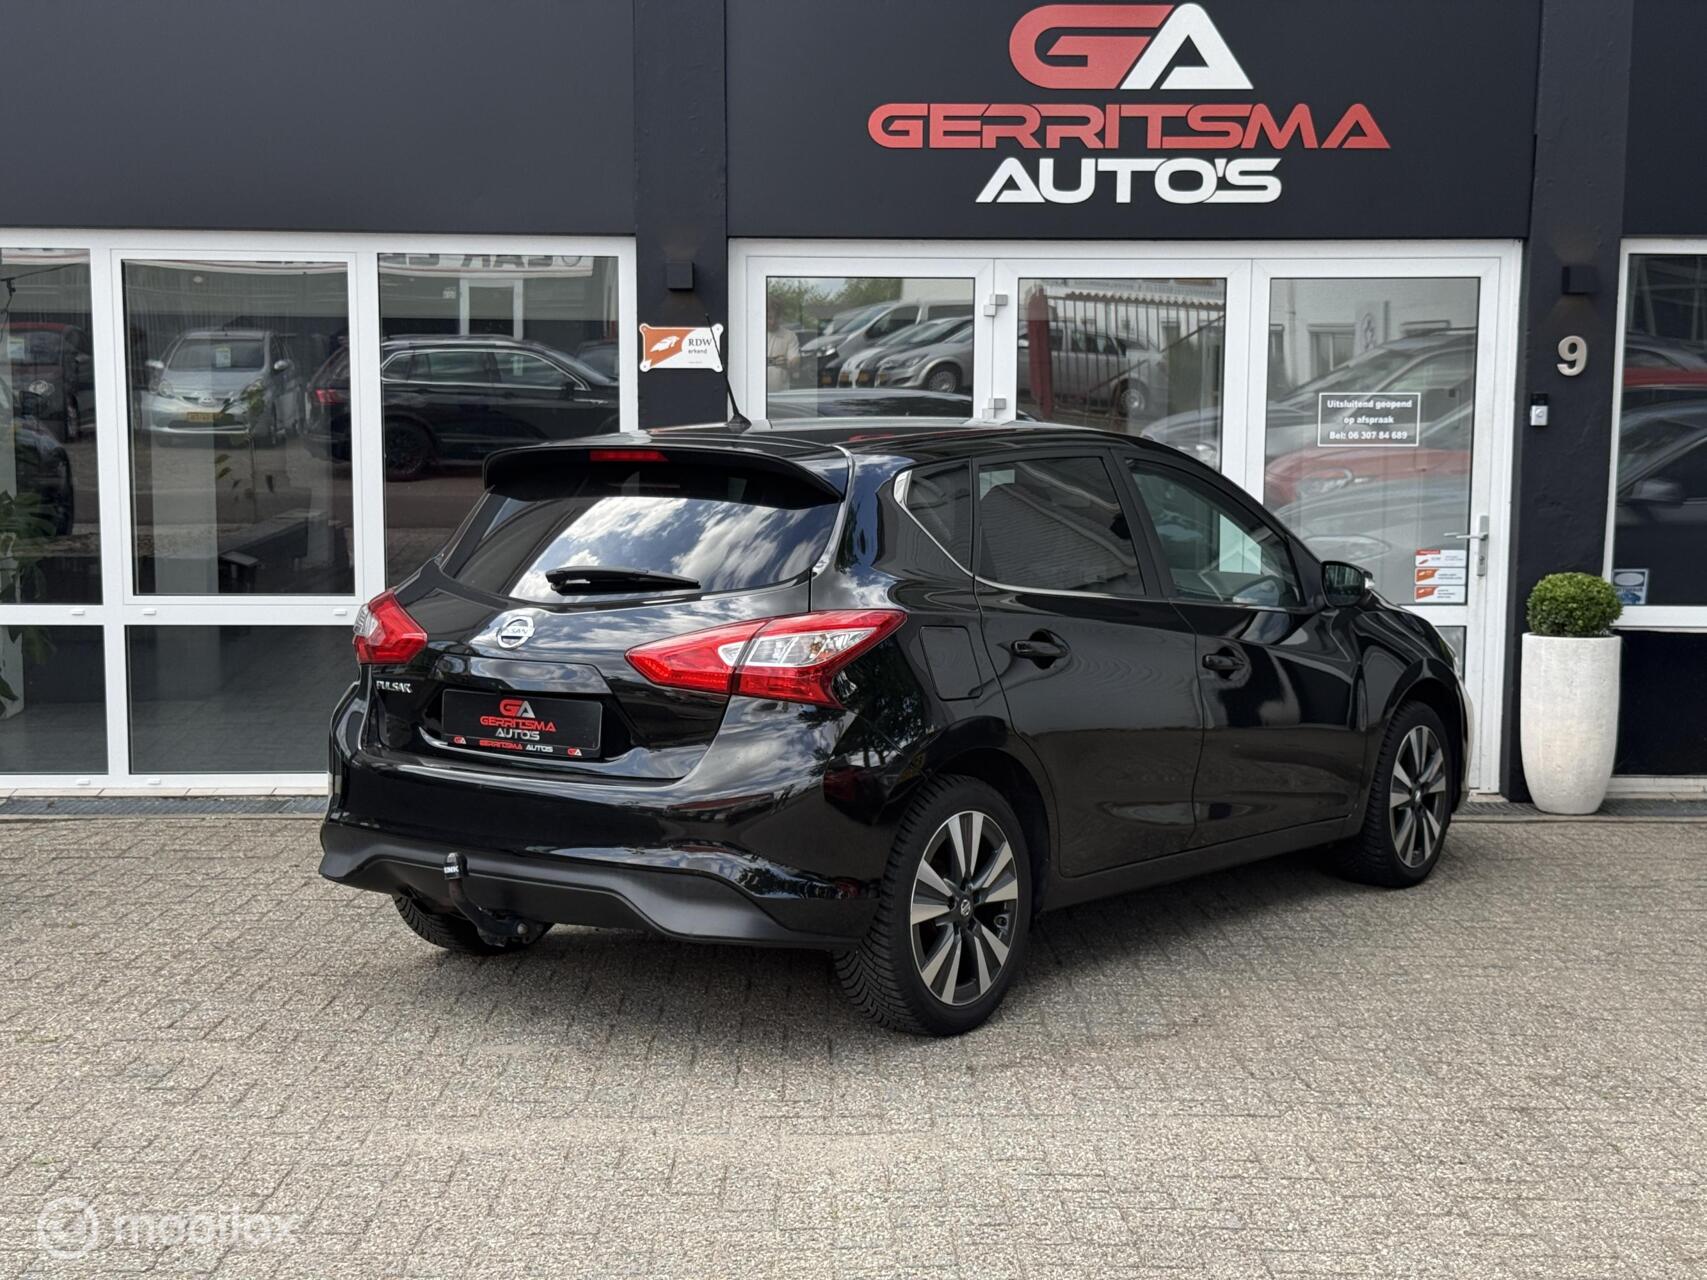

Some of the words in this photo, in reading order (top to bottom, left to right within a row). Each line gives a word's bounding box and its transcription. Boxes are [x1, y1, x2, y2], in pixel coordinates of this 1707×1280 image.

[1009, 3, 1254, 90] GA
[868, 103, 1391, 149] GERRITSMA
[975, 157, 1282, 204] AUTO'S
[1557, 335, 1588, 376] 9
[1327, 400, 1374, 408] Uitsluitend
[1375, 400, 1412, 409] geopend
[1344, 417, 1355, 425] op
[1356, 415, 1394, 425] afspraak
[1347, 431, 1359, 440] 06
[1361, 431, 1376, 440] 307
[1378, 431, 1390, 440] 84
[1391, 431, 1408, 440] 689
[376, 681, 412, 693] PULSAR
[499, 699, 535, 718] GA
[480, 715, 557, 732] GERRITSMA
[453, 736, 467, 745] GA
[479, 739, 523, 750] GERRITSMA
[567, 747, 582, 757] GA
